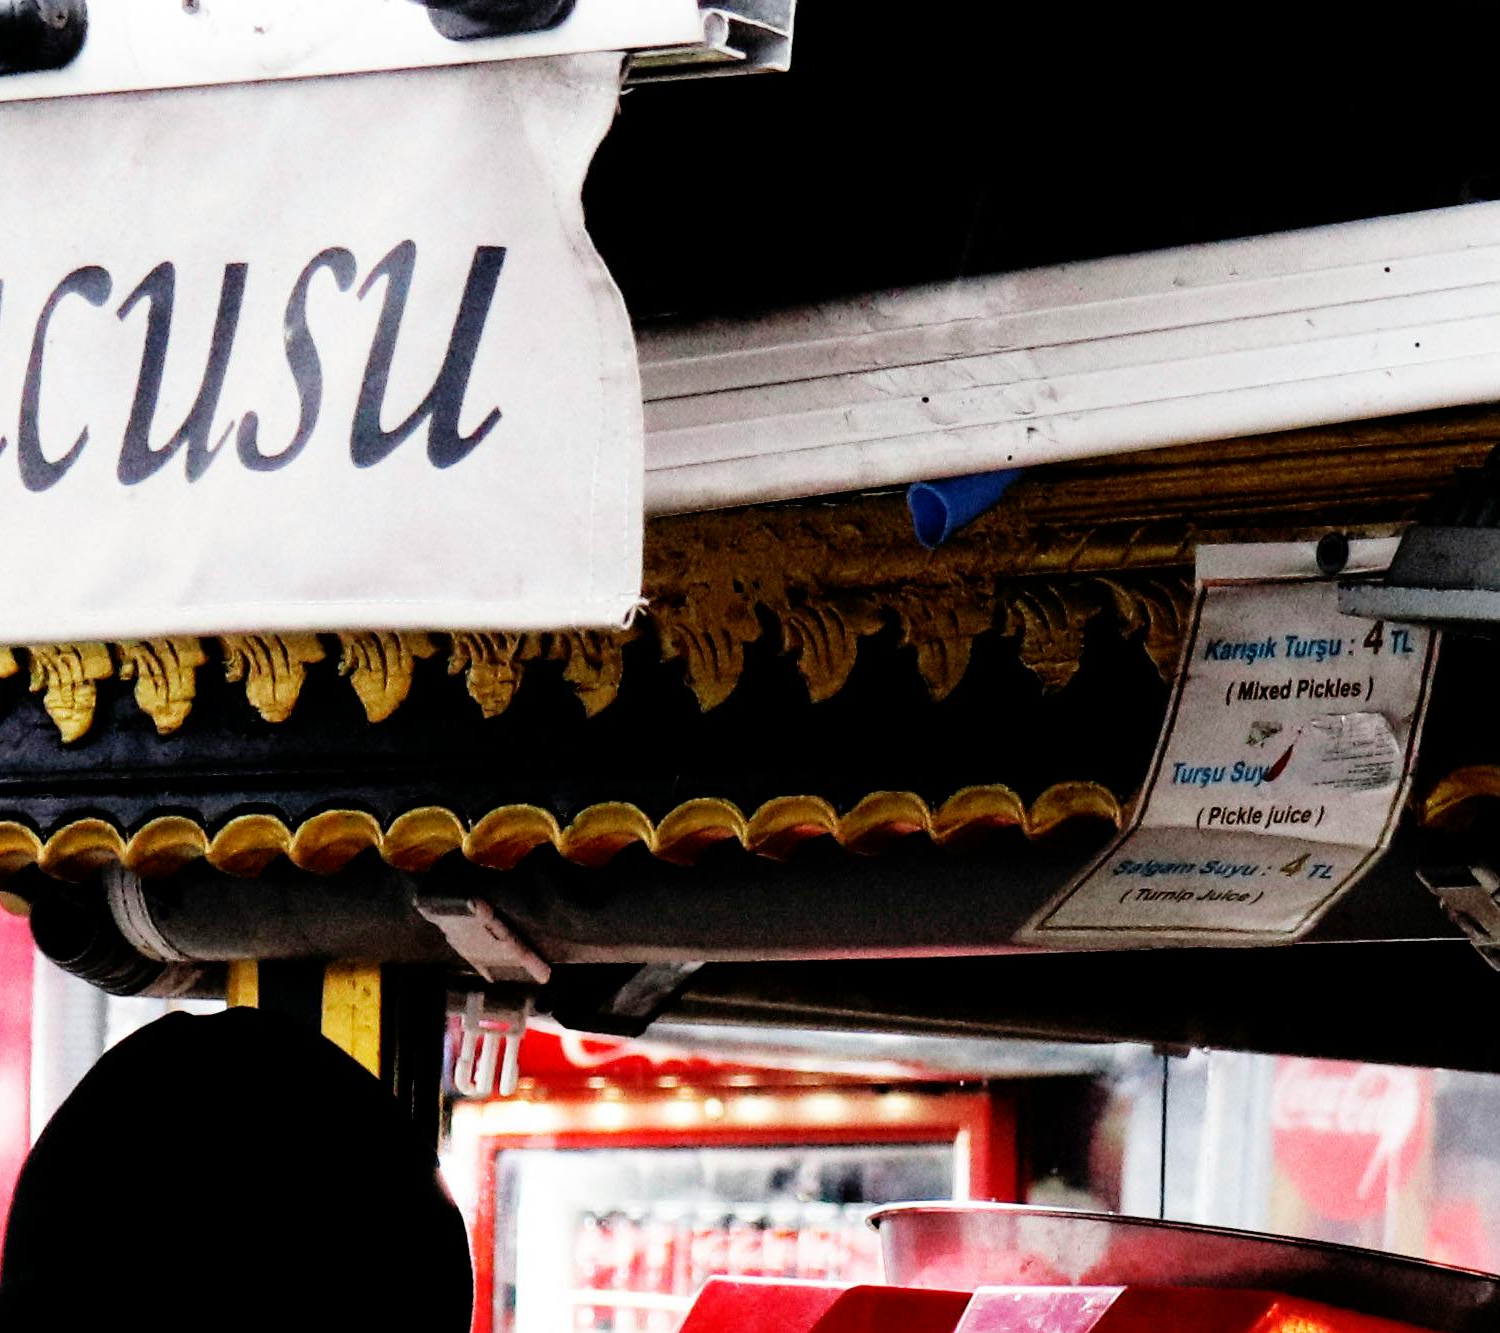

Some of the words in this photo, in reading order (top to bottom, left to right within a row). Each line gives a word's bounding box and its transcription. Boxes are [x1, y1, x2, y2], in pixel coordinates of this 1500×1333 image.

[1203, 636, 1277, 665] Karışık
[1285, 634, 1342, 662] Turşu
[1363, 620, 1385, 655] 4
[1390, 629, 1414, 654] TL
[1238, 678, 1292, 700] Mixed
[1296, 678, 1362, 699] Pickles
[1172, 762, 1226, 788] Turşu
[1208, 806, 1260, 825] Pickle
[1264, 806, 1312, 828] juice
[1200, 859, 1258, 878] Suyu
[1279, 852, 1312, 877] 4
[1308, 864, 1333, 880] TL
[1135, 888, 1195, 903] Turnip
